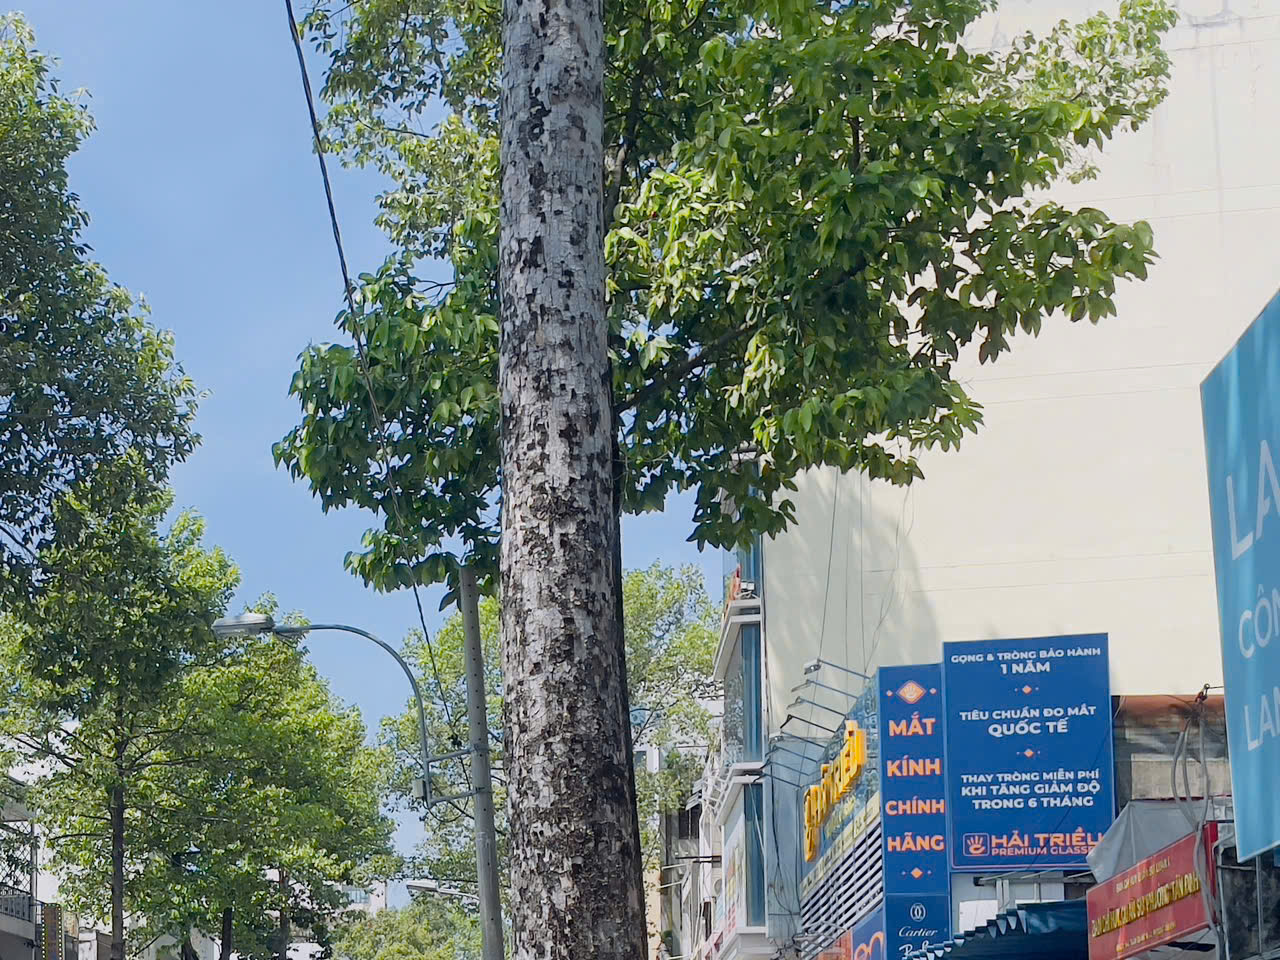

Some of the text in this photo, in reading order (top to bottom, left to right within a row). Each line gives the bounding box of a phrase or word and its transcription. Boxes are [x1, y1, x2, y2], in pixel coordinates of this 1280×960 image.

[951, 653, 984, 664] GỌNG
[987, 653, 995, 661] &
[997, 649, 1037, 661] TRÒNG
[1067, 646, 1101, 657] HÀNH
[1001, 660, 1050, 674] 1 NĂM
[960, 707, 989, 720] TIÊU
[1043, 707, 1064, 717] ĐO
[1067, 703, 1097, 716] MẮT
[888, 711, 936, 736] MẮT
[988, 717, 1069, 737] QUỐC TẾ
[887, 755, 941, 777] KÍNH
[961, 773, 994, 783] THAY
[998, 771, 1040, 782] TRÒNG
[1077, 768, 1099, 779] PHÍ
[961, 786, 986, 796] KHI
[990, 782, 1030, 795] TĂNG
[1077, 779, 1100, 794] ĐỘ
[885, 795, 945, 815] CHÍNH
[972, 794, 1093, 809] TRONG 6 THÁNG
[887, 832, 944, 851] HÃNG
[991, 829, 1029, 848] HẢI
[991, 846, 1047, 856] PREMIUM
[898, 926, 938, 937] Cartier
